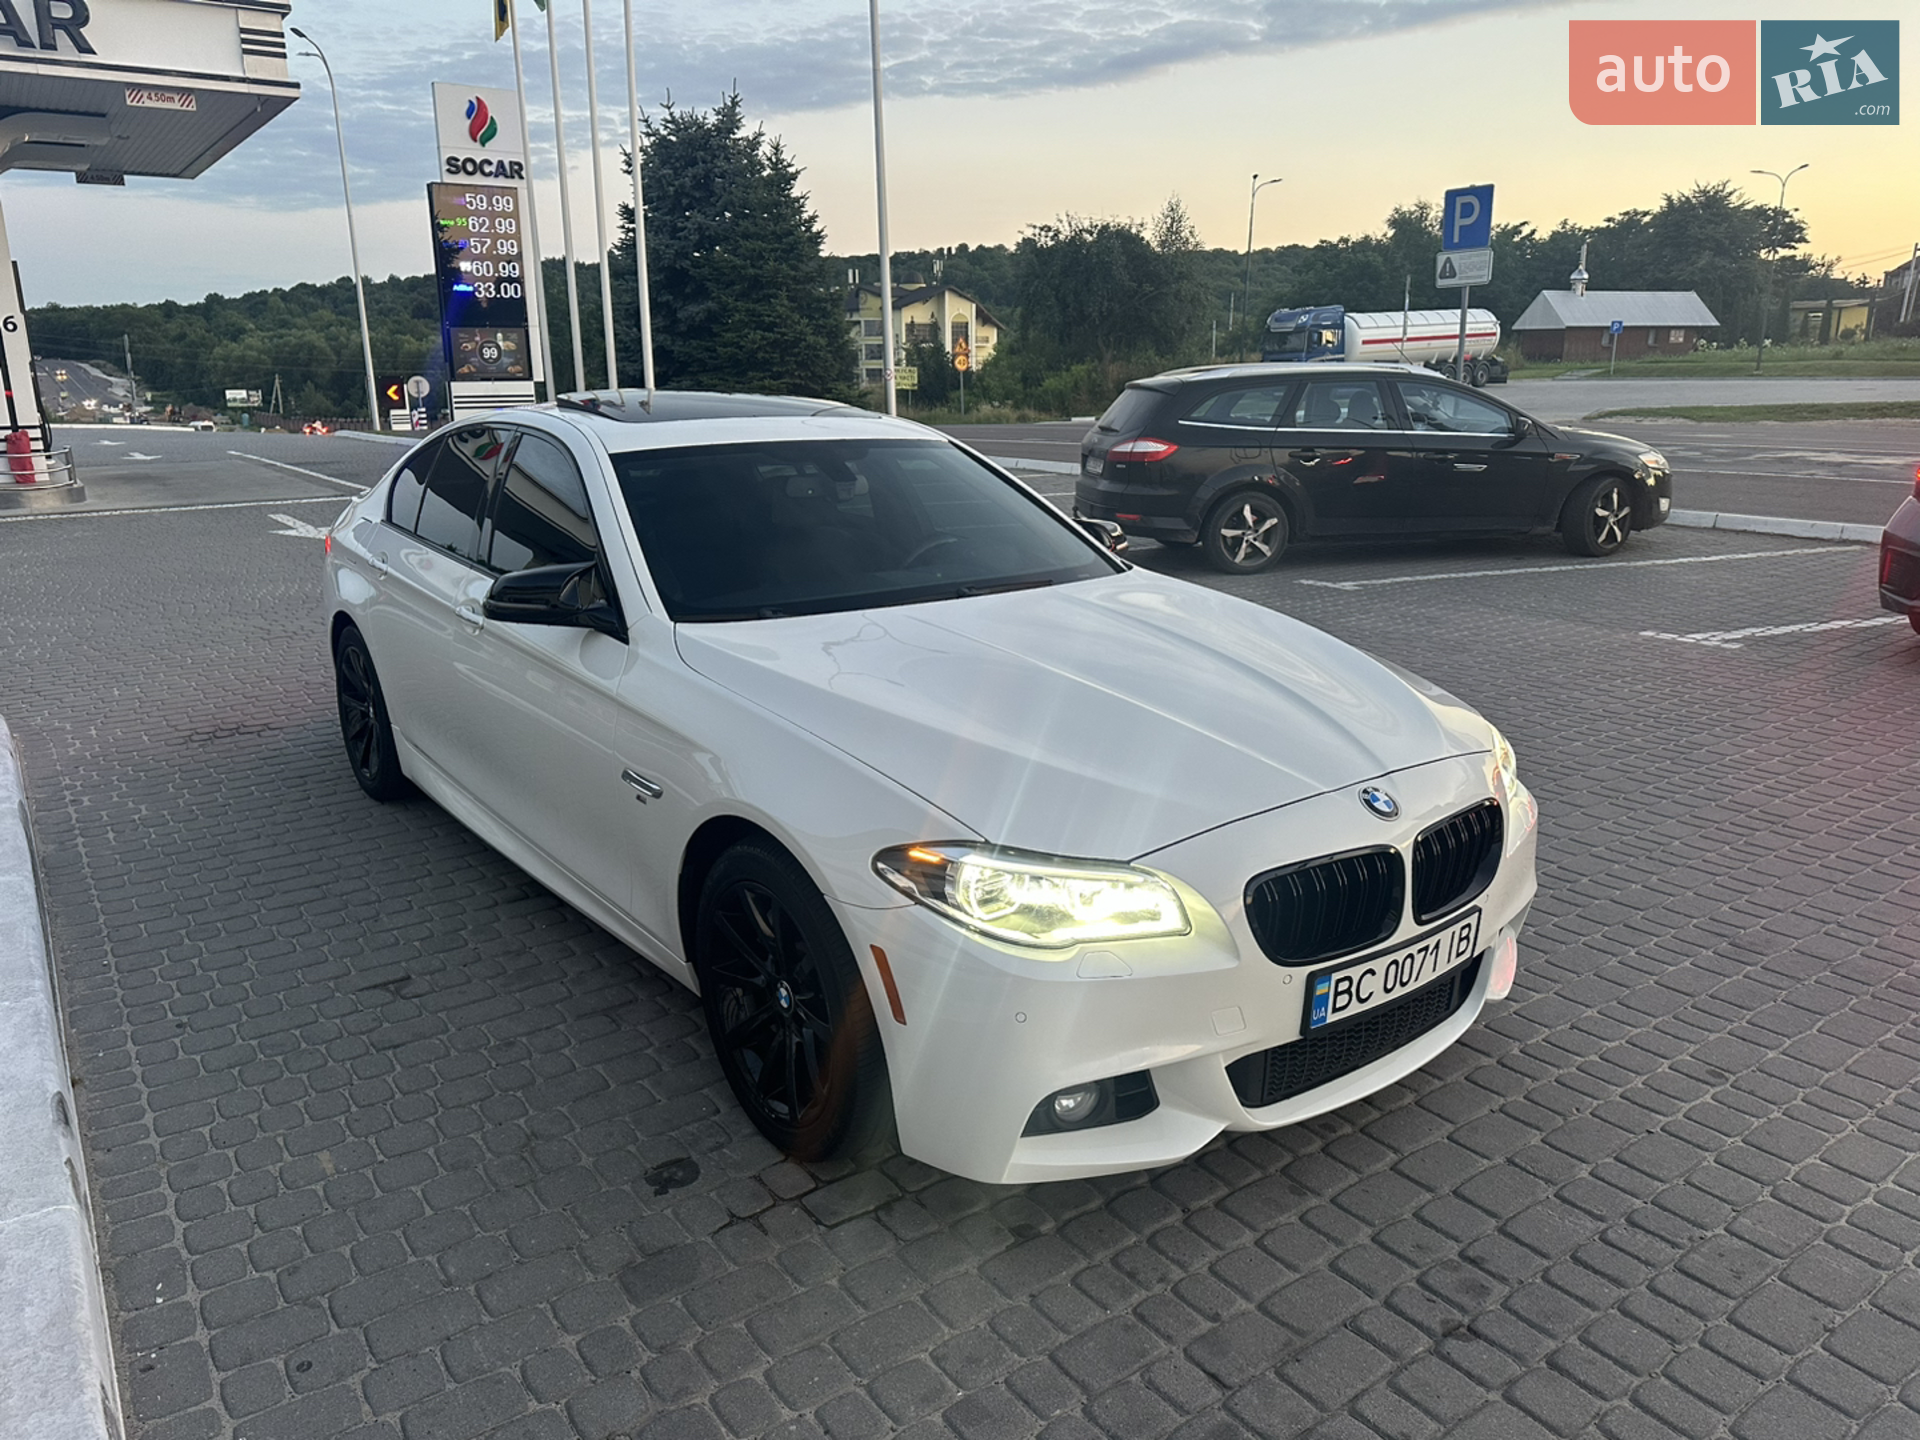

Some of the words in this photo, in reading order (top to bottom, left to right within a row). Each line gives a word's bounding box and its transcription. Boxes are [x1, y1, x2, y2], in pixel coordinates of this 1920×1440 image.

[146, 92, 175, 104] 4.50m
[445, 155, 525, 180] SOCAR
[464, 193, 513, 212] 59.99
[468, 217, 516, 234] 62.99
[1453, 195, 1480, 243] P
[470, 237, 518, 255] 57.99
[472, 261, 520, 278] 60.99
[474, 282, 522, 299] 33.00
[3, 315, 18, 333] 6
[482, 347, 498, 359] 99
[1331, 968, 1377, 1014] BC
[1383, 938, 1442, 994] 0071
[1446, 922, 1472, 964] IB
[1312, 1006, 1326, 1021] UA
